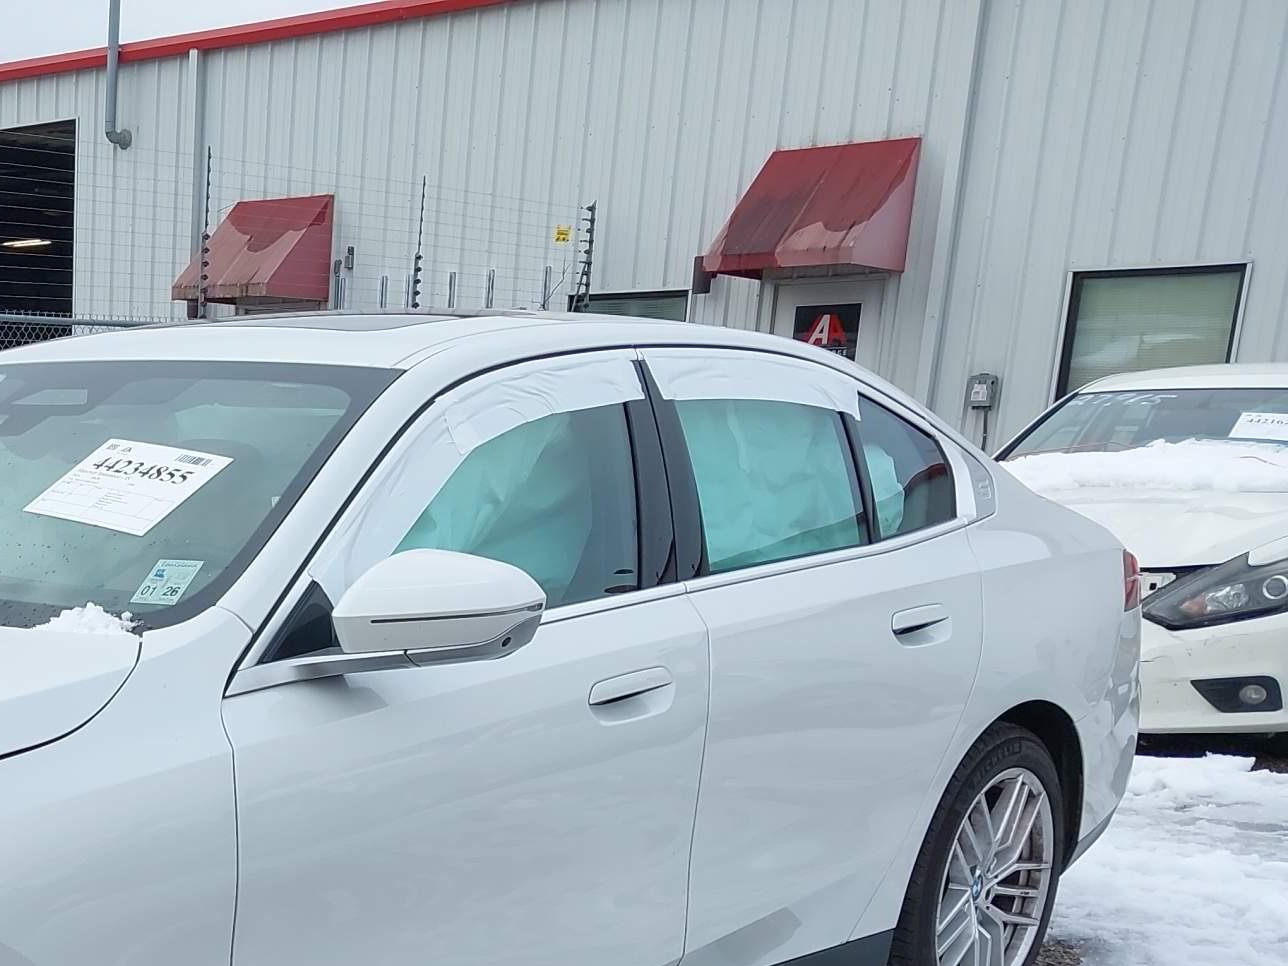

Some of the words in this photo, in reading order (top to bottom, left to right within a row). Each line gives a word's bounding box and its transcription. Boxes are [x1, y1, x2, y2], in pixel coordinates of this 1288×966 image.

[93, 457, 195, 485] 44234855
[140, 585, 157, 597] 01
[162, 586, 181, 597] 26
